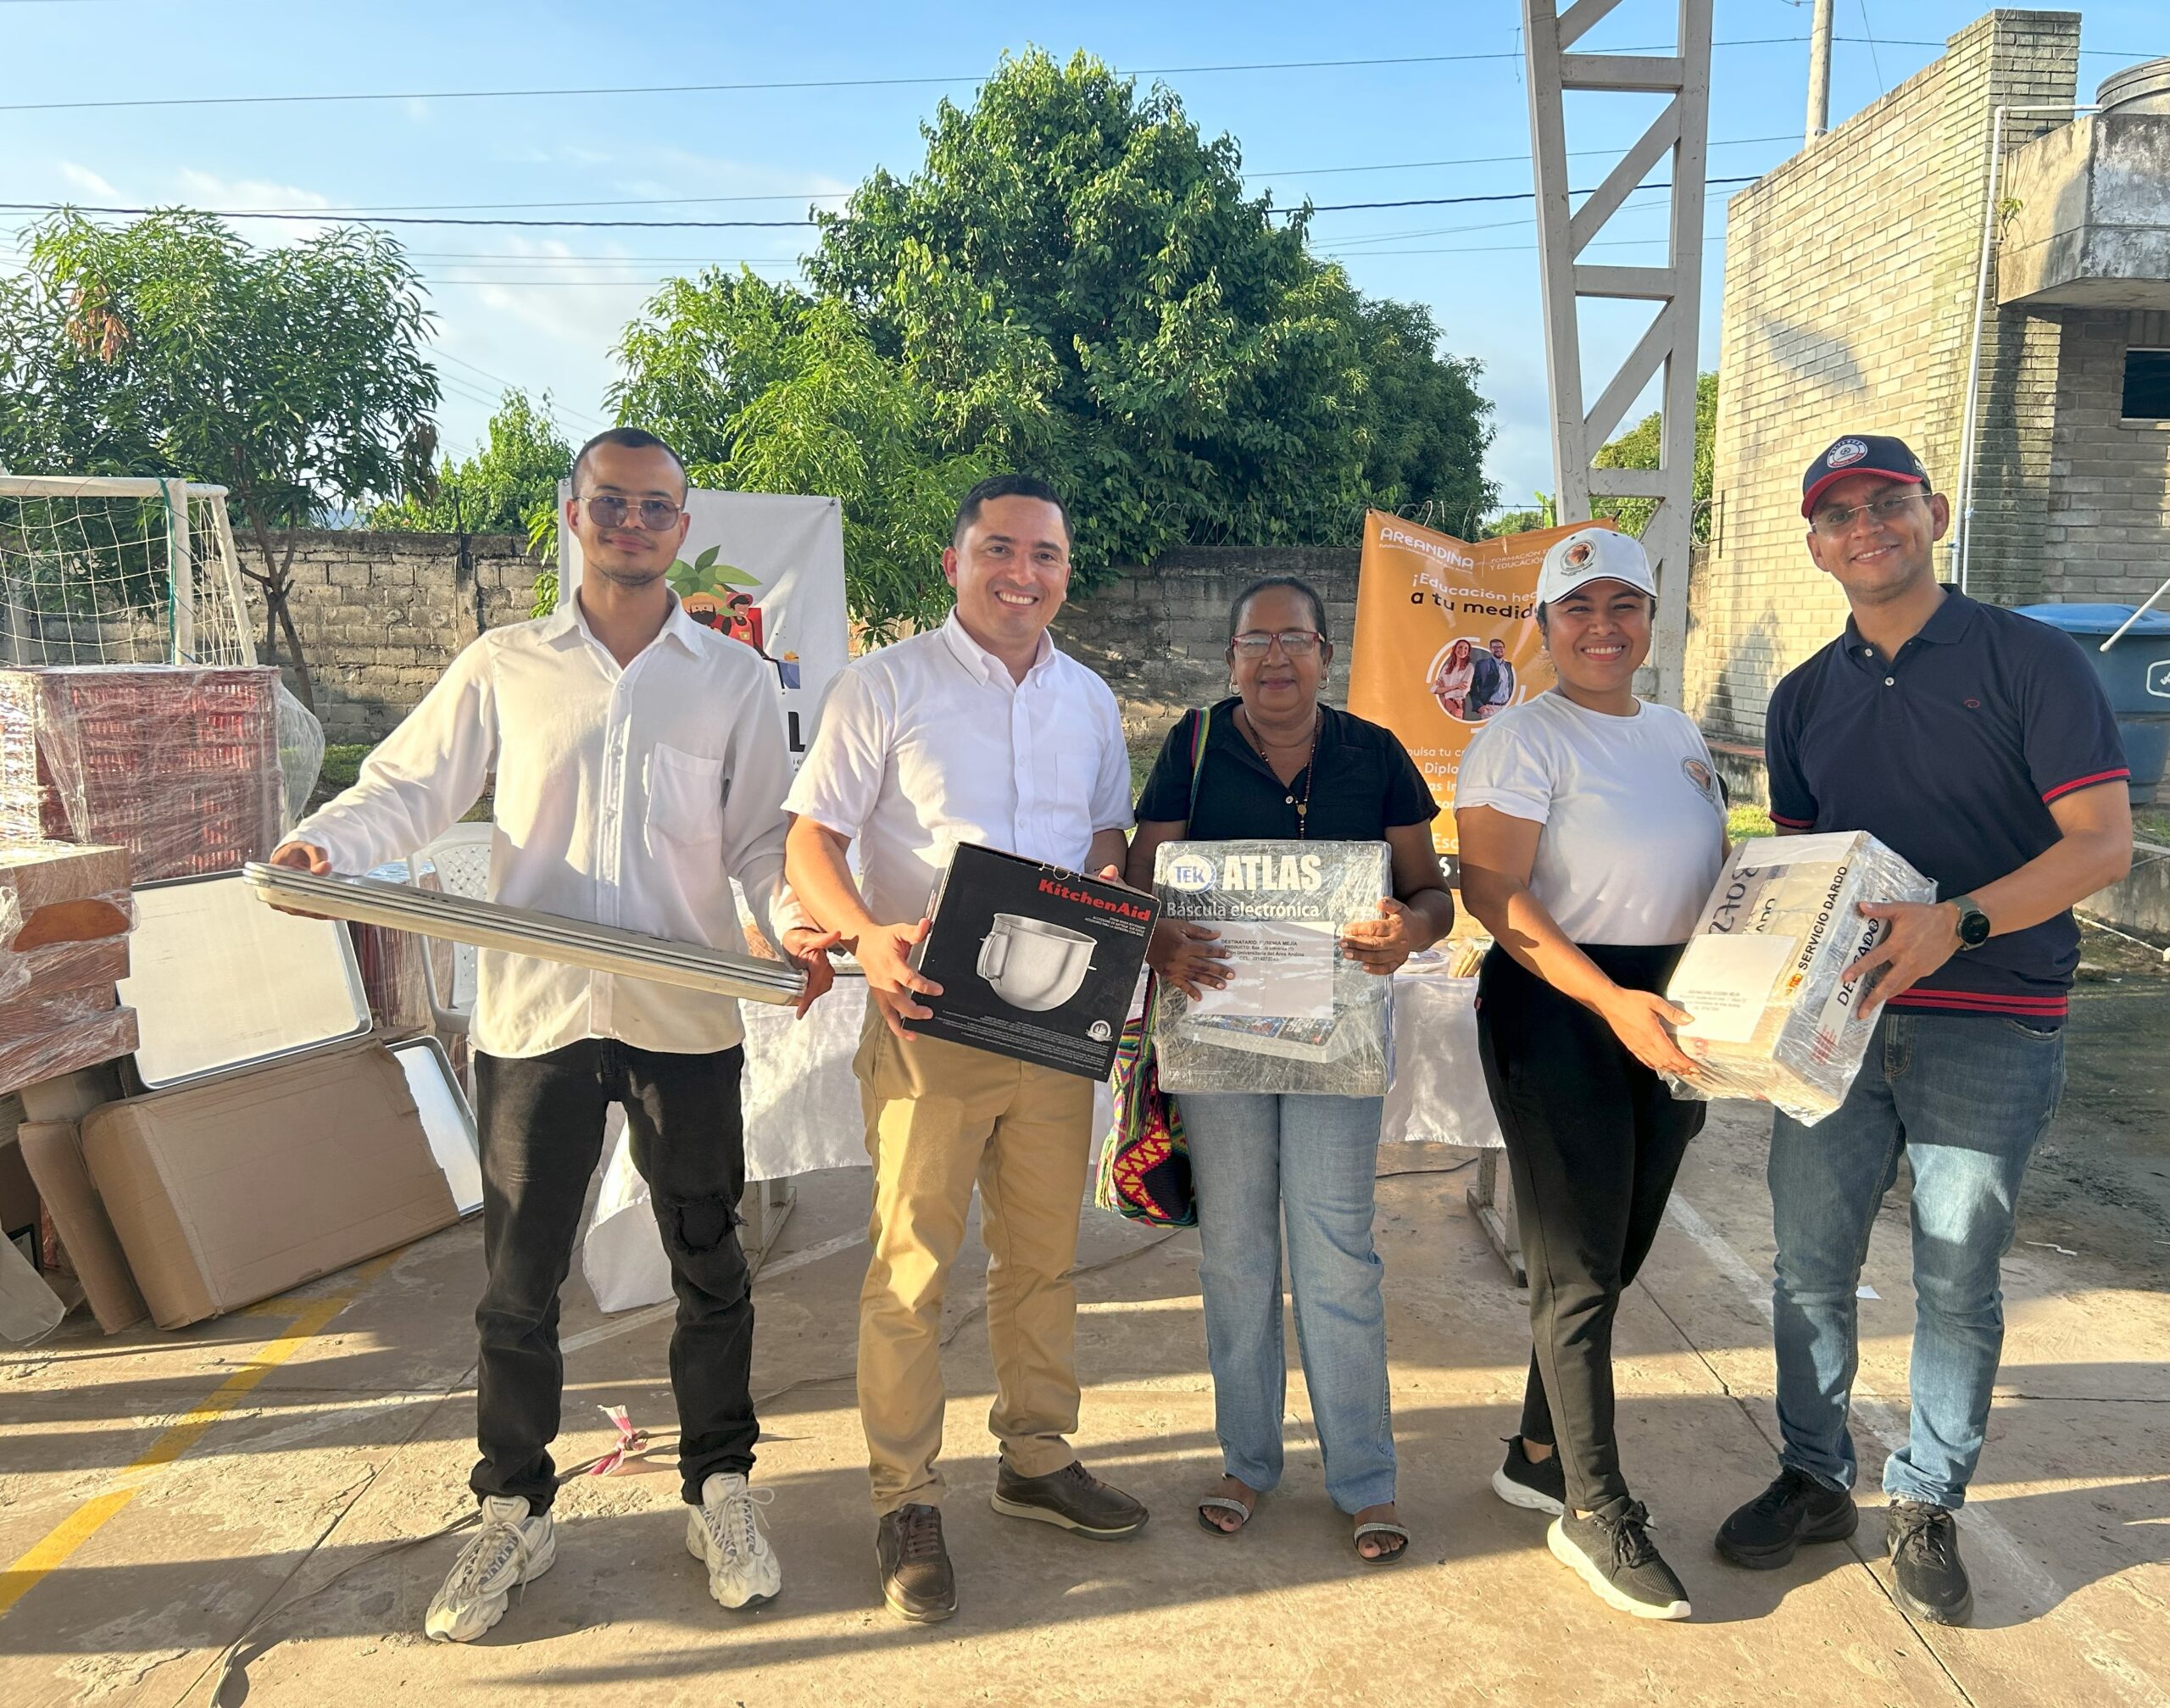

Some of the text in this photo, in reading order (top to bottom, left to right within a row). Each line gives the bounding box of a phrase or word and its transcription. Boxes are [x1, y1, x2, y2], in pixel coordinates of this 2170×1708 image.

[1412, 572, 1506, 602] ¡Educación
[1410, 592, 1538, 620] a tu medid
[1438, 748, 1451, 757] tu
[1425, 762, 1459, 777] Diplo
[1222, 854, 1322, 891] ATLAS
[1038, 878, 1152, 921] KitchenAid
[1166, 901, 1320, 918] Báscula electrónica
[1798, 866, 1848, 970] SERVICIO DARDO
